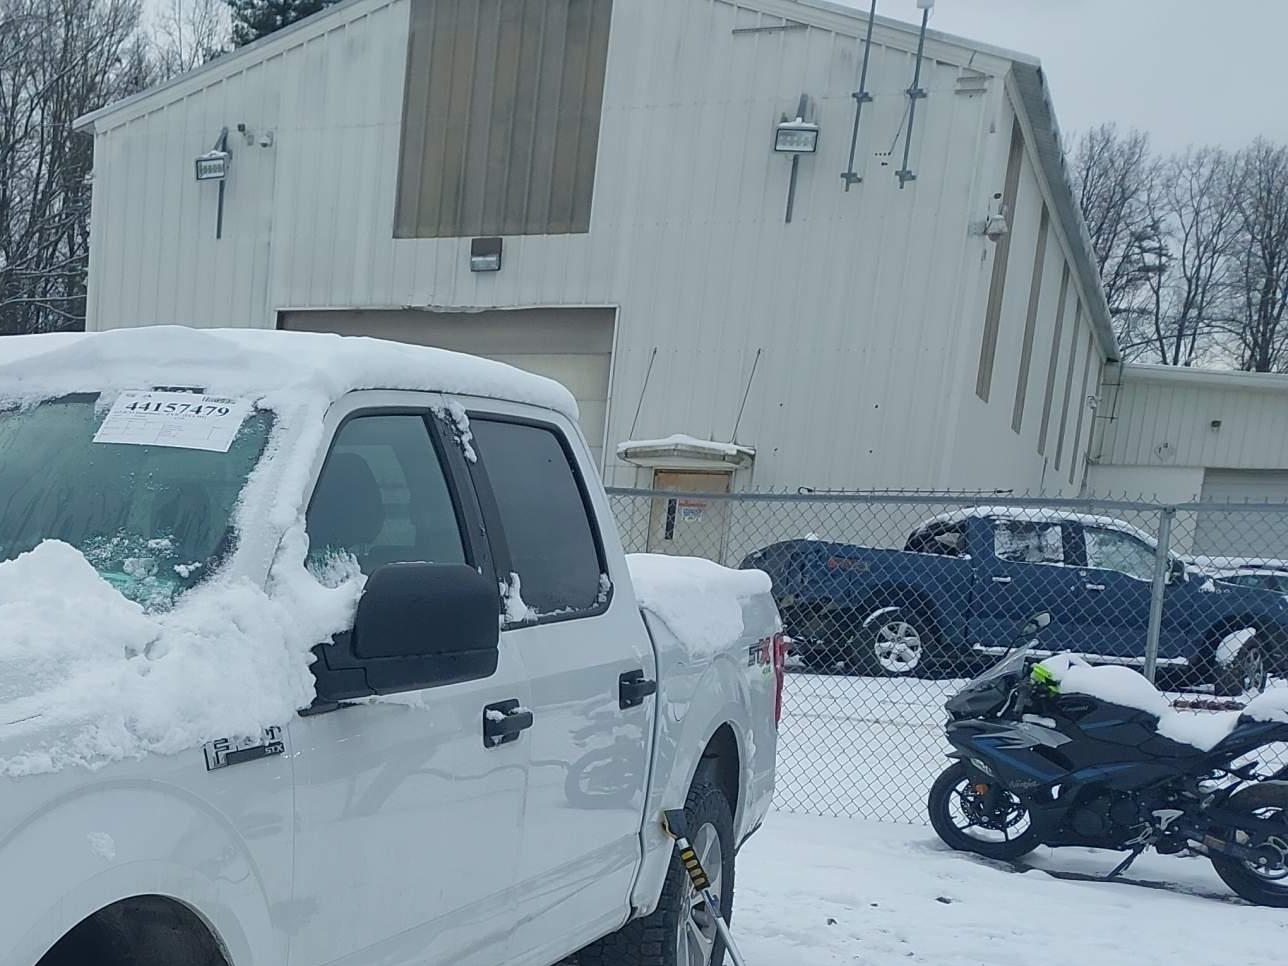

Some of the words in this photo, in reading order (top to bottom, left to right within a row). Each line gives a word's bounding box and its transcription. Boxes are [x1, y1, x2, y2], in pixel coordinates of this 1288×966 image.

[126, 401, 230, 417] 44157479
[747, 636, 771, 667] STX
[264, 743, 285, 754] STX
